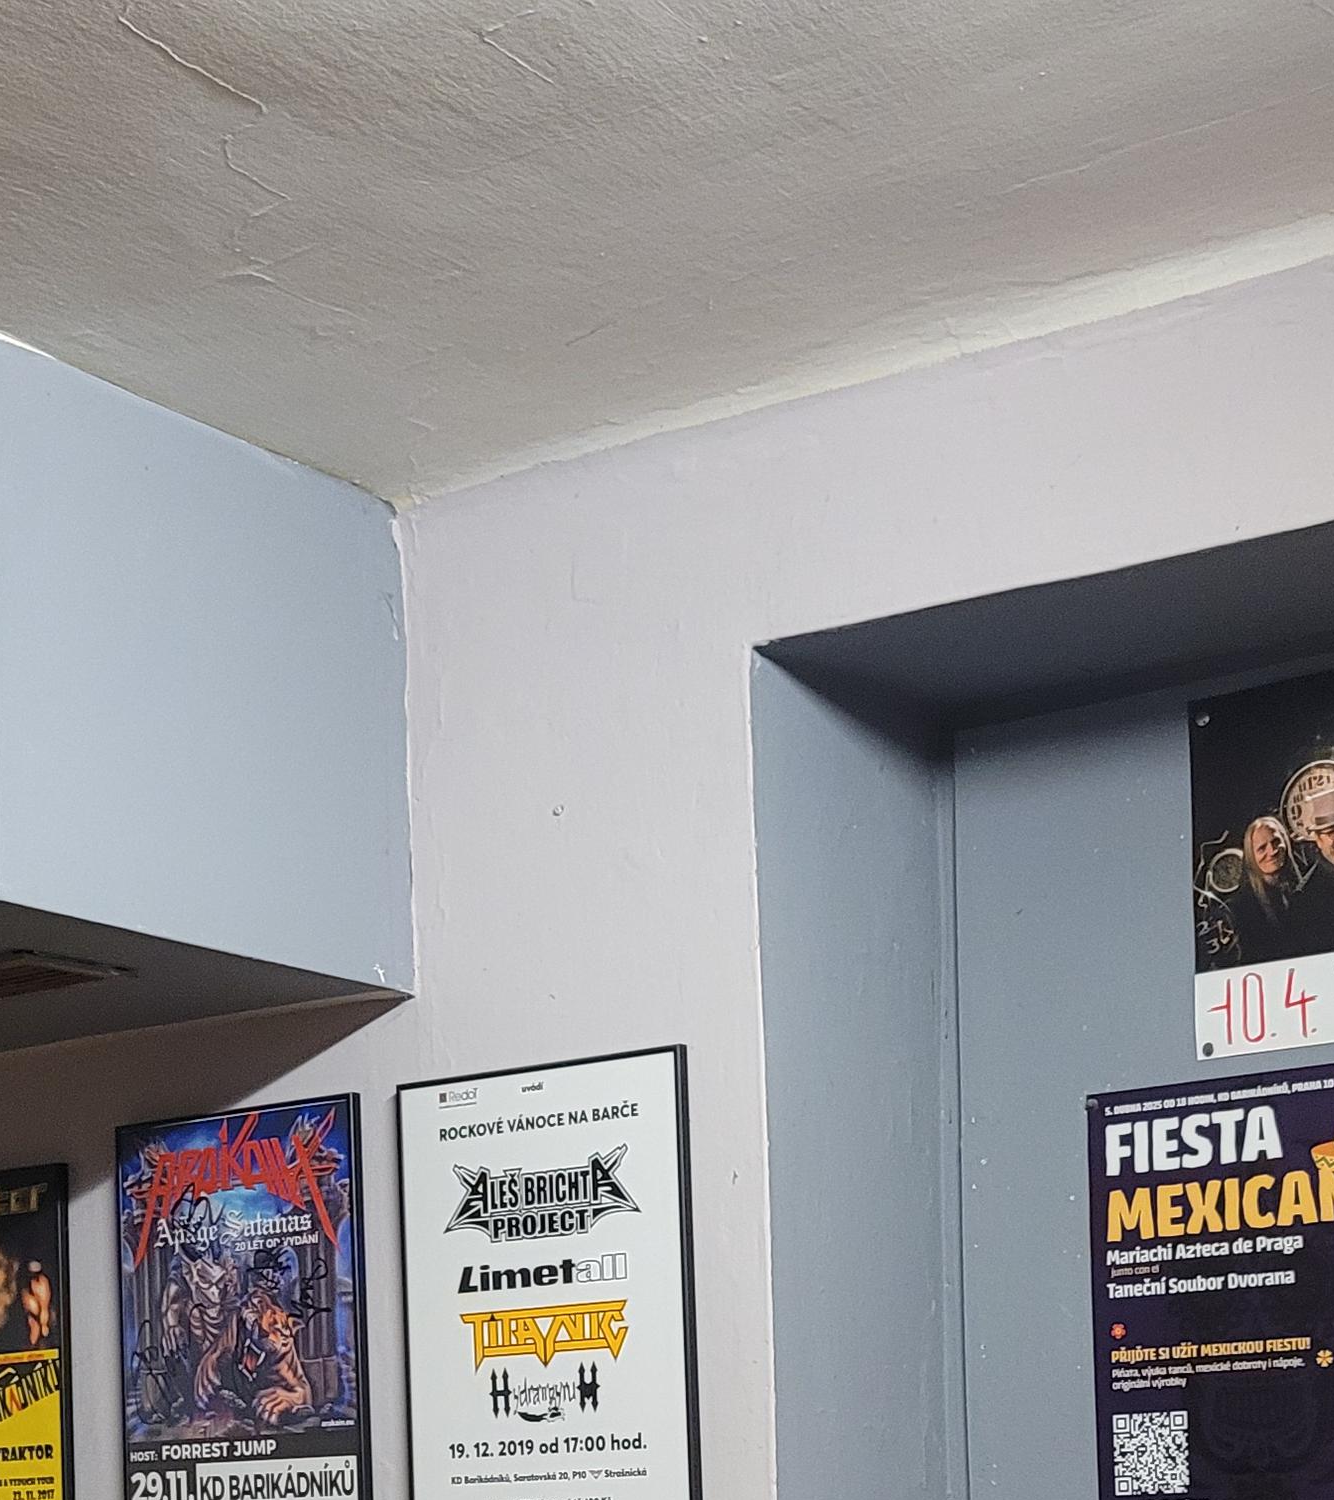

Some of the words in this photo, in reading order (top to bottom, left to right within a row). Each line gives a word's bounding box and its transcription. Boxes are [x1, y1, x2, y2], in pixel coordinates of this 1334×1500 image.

[439, 1118, 505, 1142] ROCKOVÉ
[507, 1111, 565, 1133] VÁNOCE
[568, 1110, 589, 1125] NA
[591, 1100, 639, 1122] BARČE
[1105, 1105, 1283, 1177] FIESTA
[492, 1208, 590, 1241] PROJECT
[235, 1242, 246, 1252] 20
[248, 1240, 264, 1250] LET
[1107, 1245, 1173, 1266] Mariachi
[1175, 1239, 1229, 1260] Azteca
[1232, 1240, 1253, 1254] de
[1256, 1234, 1304, 1254] Praga
[458, 1253, 627, 1294] Limetall
[1107, 1276, 1166, 1299] Taneční
[1169, 1272, 1224, 1294] Soubor
[1228, 1270, 1295, 1290] Dvorana
[130, 1451, 158, 1462] HOST:
[162, 1442, 229, 1461] FORREST
[233, 1439, 277, 1456] JUMP
[449, 1443, 469, 1459] 19.
[473, 1442, 494, 1458] 12.
[498, 1440, 534, 1457] 2019
[539, 1437, 558, 1454] od
[563, 1436, 606, 1452] 17:00
[611, 1432, 647, 1450] hod.
[229, 1460, 355, 1500] BARIKÁDNÍKŮ
